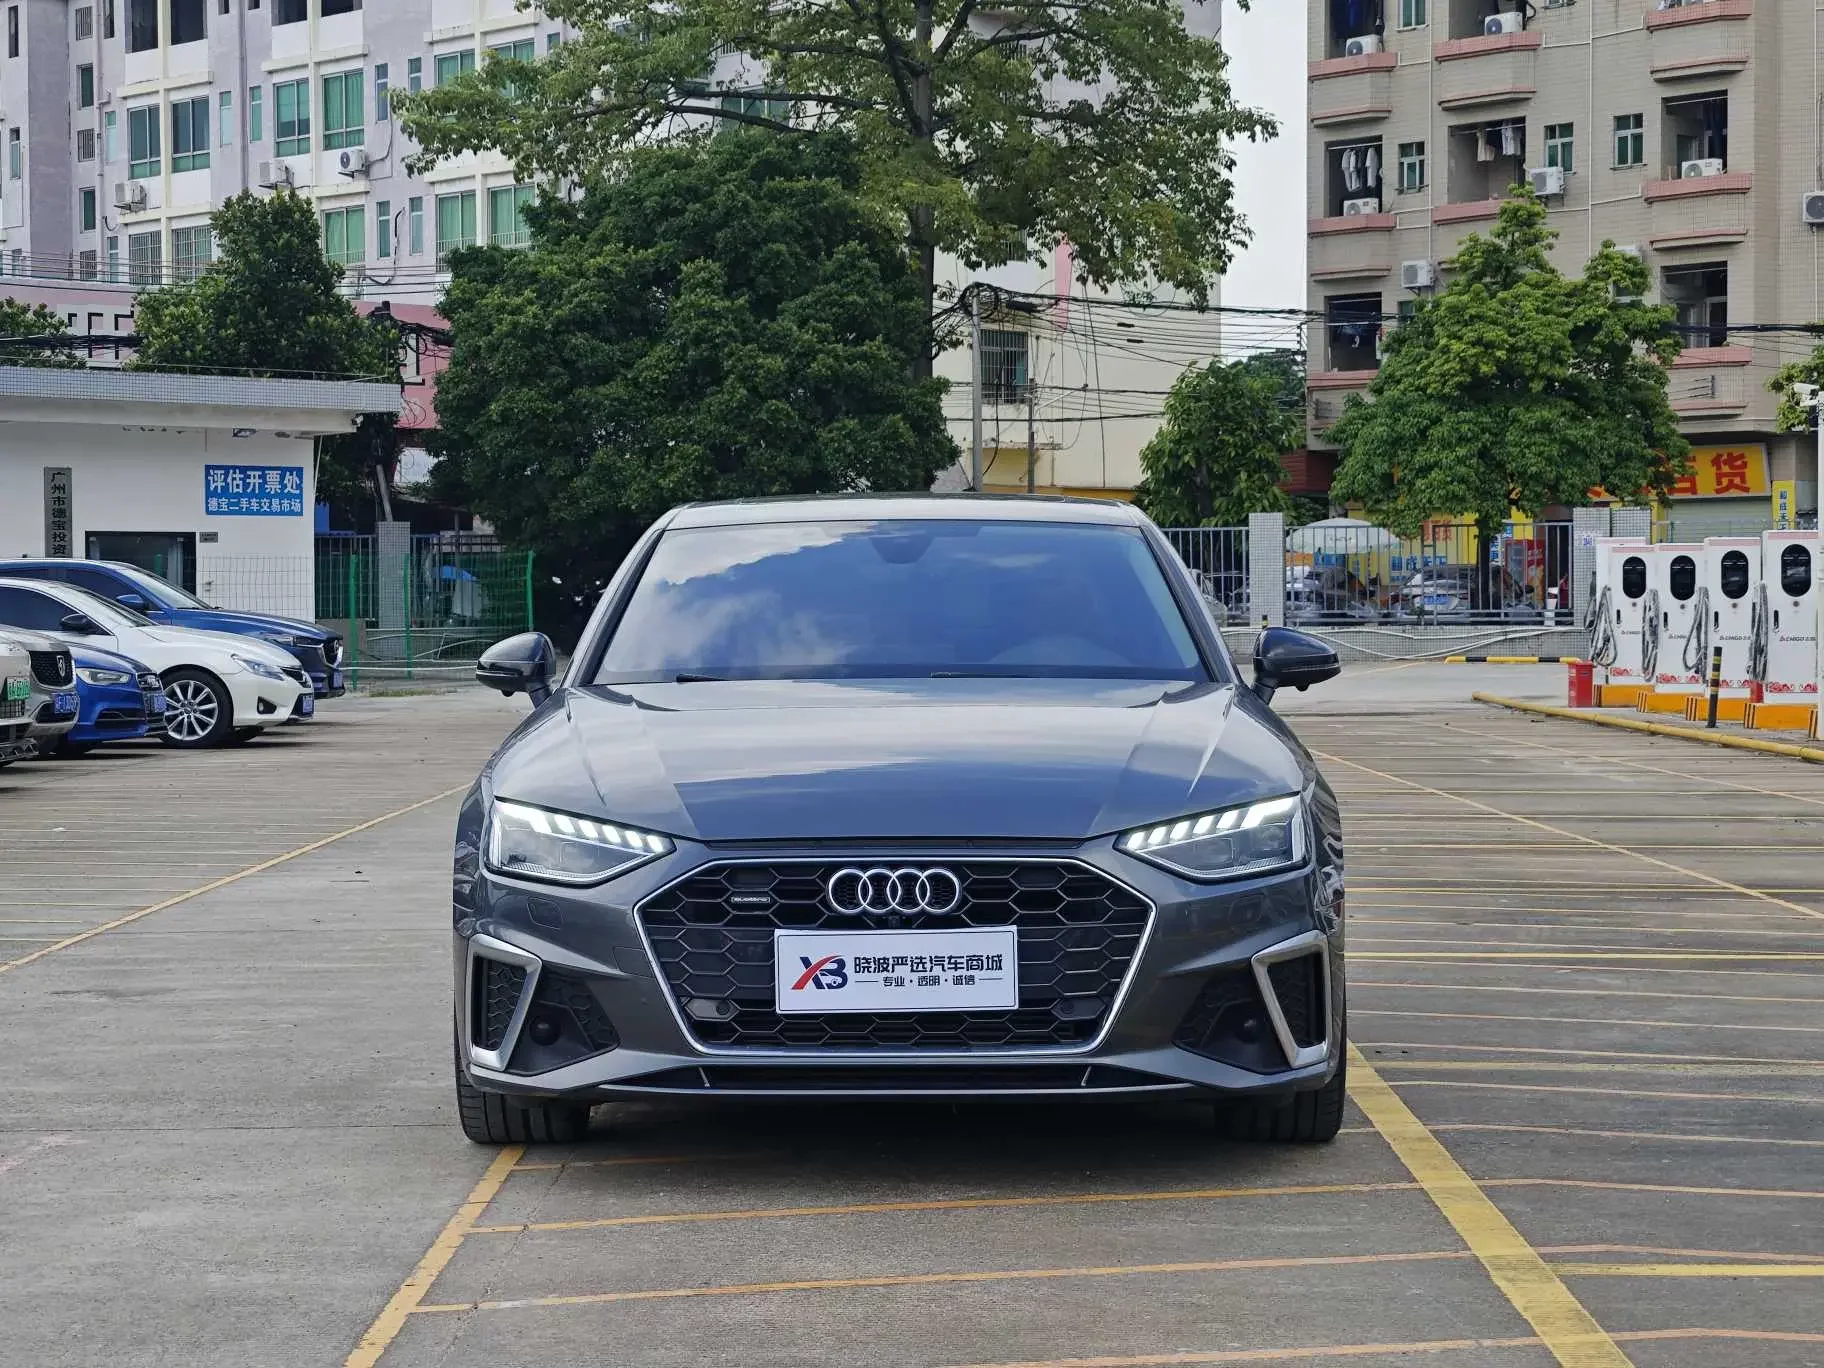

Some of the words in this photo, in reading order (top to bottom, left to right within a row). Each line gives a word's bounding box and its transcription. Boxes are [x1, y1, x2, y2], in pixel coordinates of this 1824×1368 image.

[207, 469, 300, 494] 评估开票处
[50, 471, 67, 555] 广州市德宝投资
[207, 497, 302, 513] 德宝二手车交易市场
[853, 953, 1003, 974] 晓波严选汽车商城
[882, 975, 976, 987] 专业·透明·诚信
